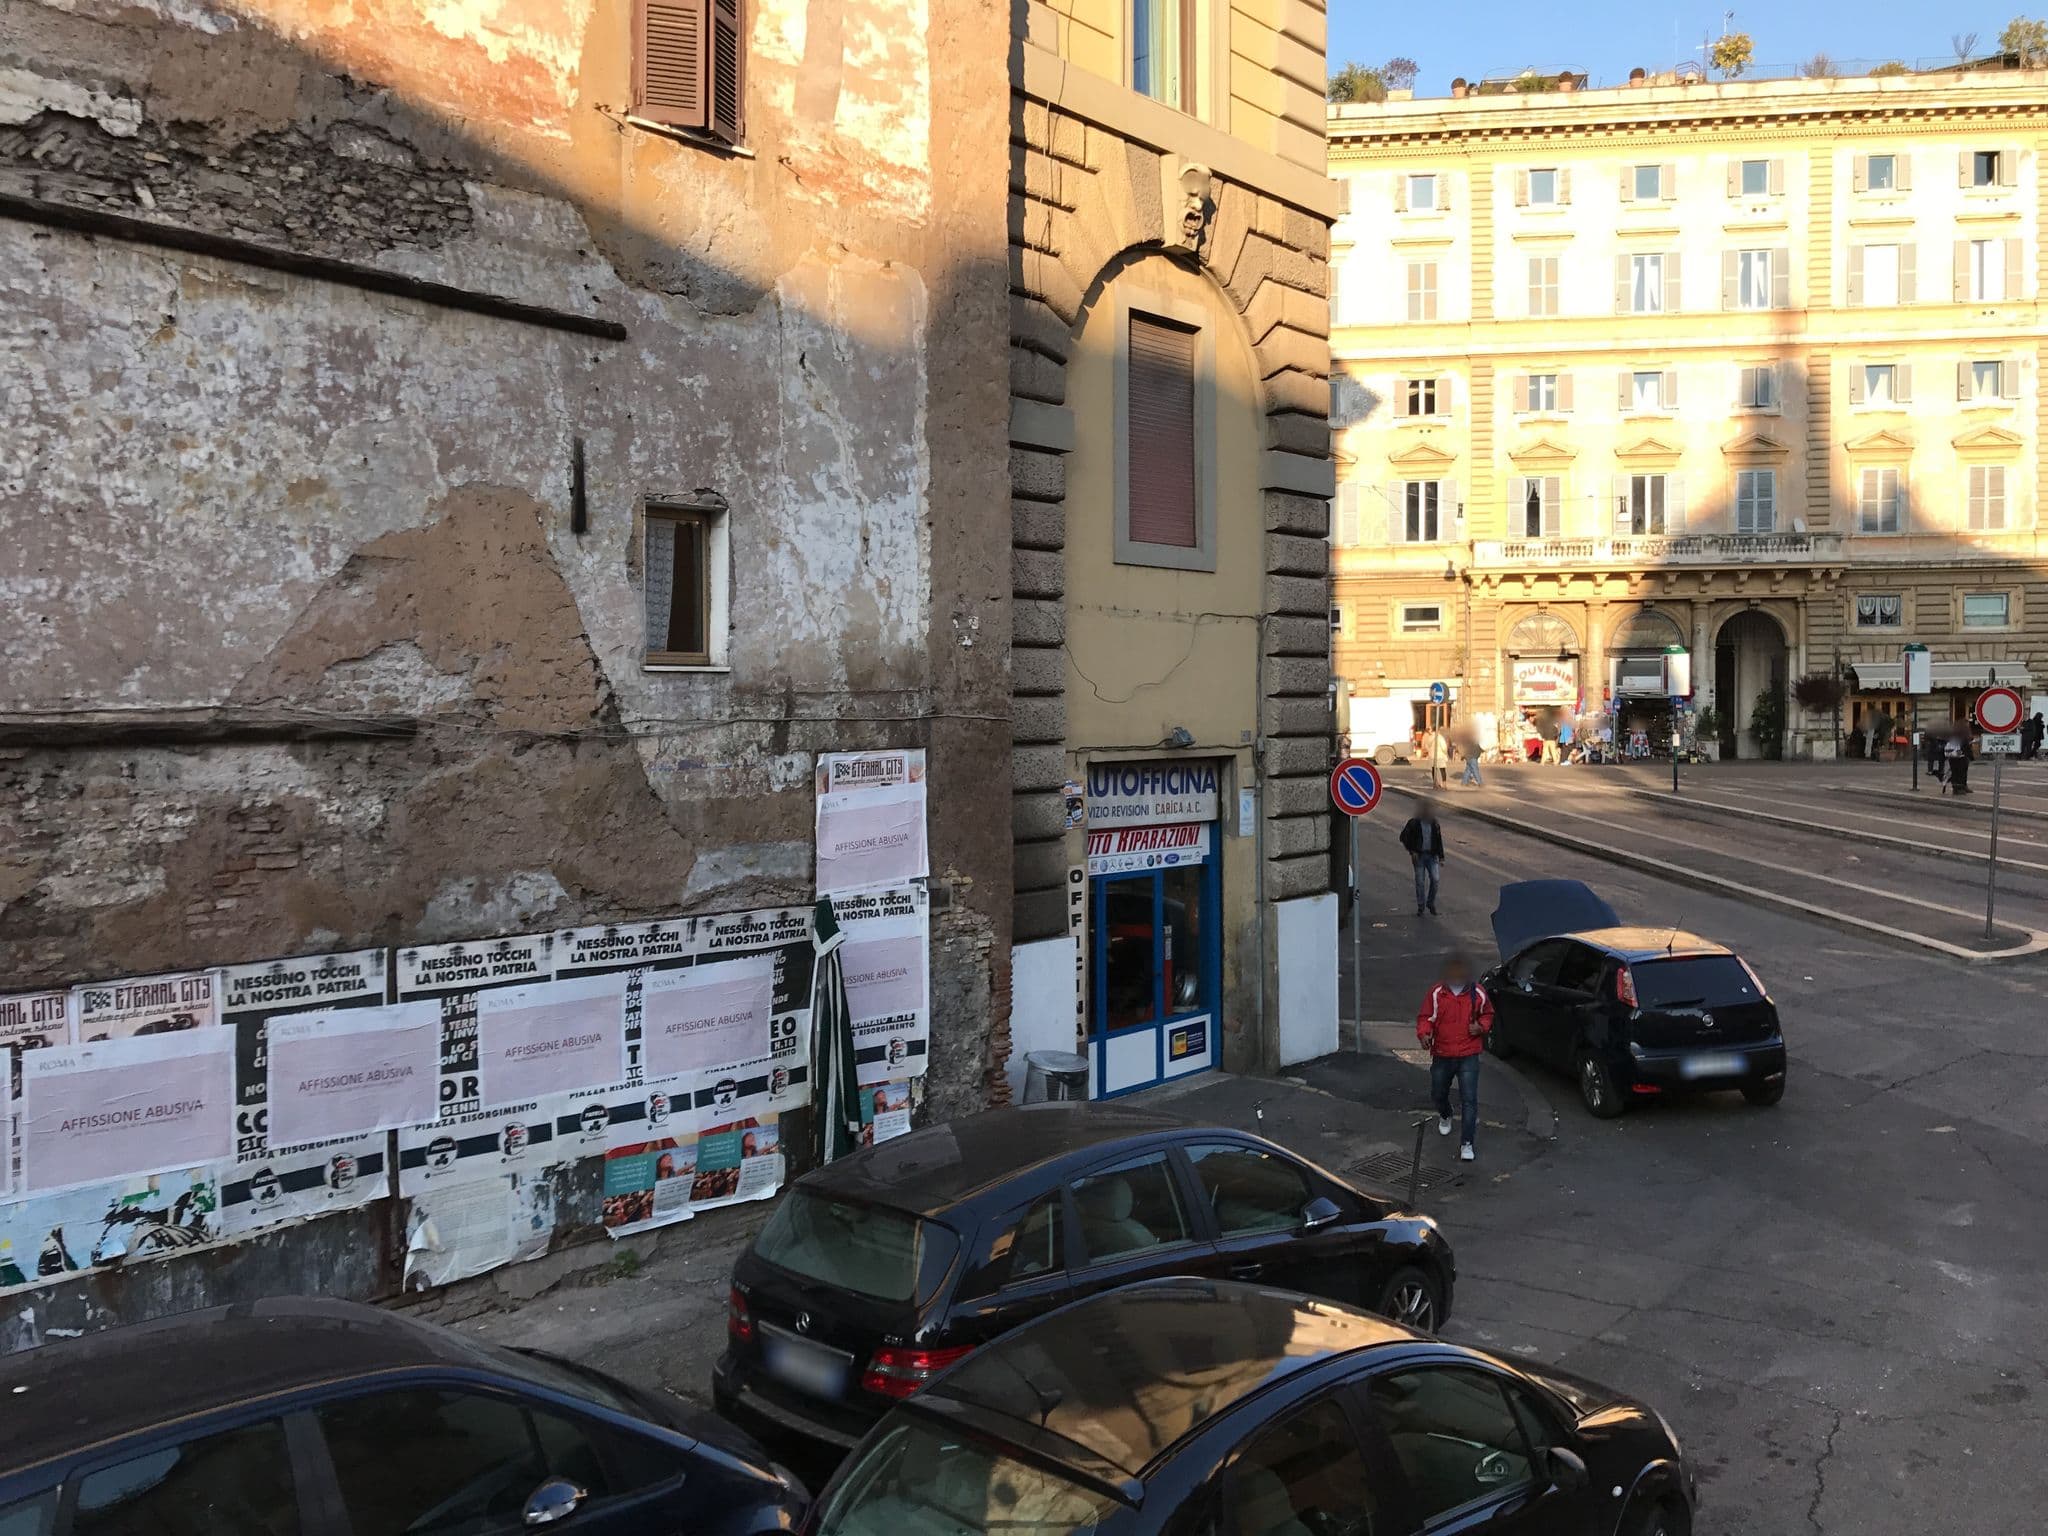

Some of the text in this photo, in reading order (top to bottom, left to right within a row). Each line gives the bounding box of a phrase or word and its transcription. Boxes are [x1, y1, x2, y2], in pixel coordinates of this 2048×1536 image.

[1966, 680, 2012, 688] PIZZRIA
[886, 758, 903, 776] CITY
[1111, 804, 1150, 818] REVISIONI
[835, 838, 876, 853] AFFISSIONE
[878, 833, 909, 845] ABUSIVA
[1116, 827, 1201, 853] RIPARAZIONI
[833, 895, 911, 911] NESSUNO TOCCHI
[843, 908, 880, 921] NOSTRA
[883, 904, 915, 917] PATRIA
[715, 918, 805, 936] NESSUNO TOCCHI
[577, 931, 680, 951] NESSUNO TOCCHI
[709, 928, 807, 948] LA NOSTRA PATRIA
[422, 949, 532, 971] NESSUNO TOCCHI
[570, 943, 683, 964] LA NOSTRA PATRIA
[234, 965, 361, 991] NESSUNO TOCCHI
[415, 961, 537, 985] LA NOSTRA PATRIA
[876, 967, 908, 980] ABUSIVA
[181, 977, 211, 1003] CITY
[227, 978, 368, 1007] LA NOSTRA PATRIA
[32, 995, 65, 1023] CITY
[665, 1017, 716, 1034] AFFISSIONE
[717, 1011, 753, 1025] ABUSIVA
[859, 1021, 915, 1037] RISORGIMENTO
[451, 1043, 465, 1054] LO
[505, 1039, 560, 1058] AFFISSIONE
[562, 1033, 602, 1048] ABUSIVA
[462, 1051, 473, 1061] CI
[298, 1071, 364, 1092] AFFISSIONE
[365, 1066, 414, 1082] ABUSIVA
[60, 1109, 141, 1133] AFFISSIONE
[145, 1099, 205, 1119] ABUSIVA
[415, 1102, 538, 1132] PIAZZA RISORGIMENTO
